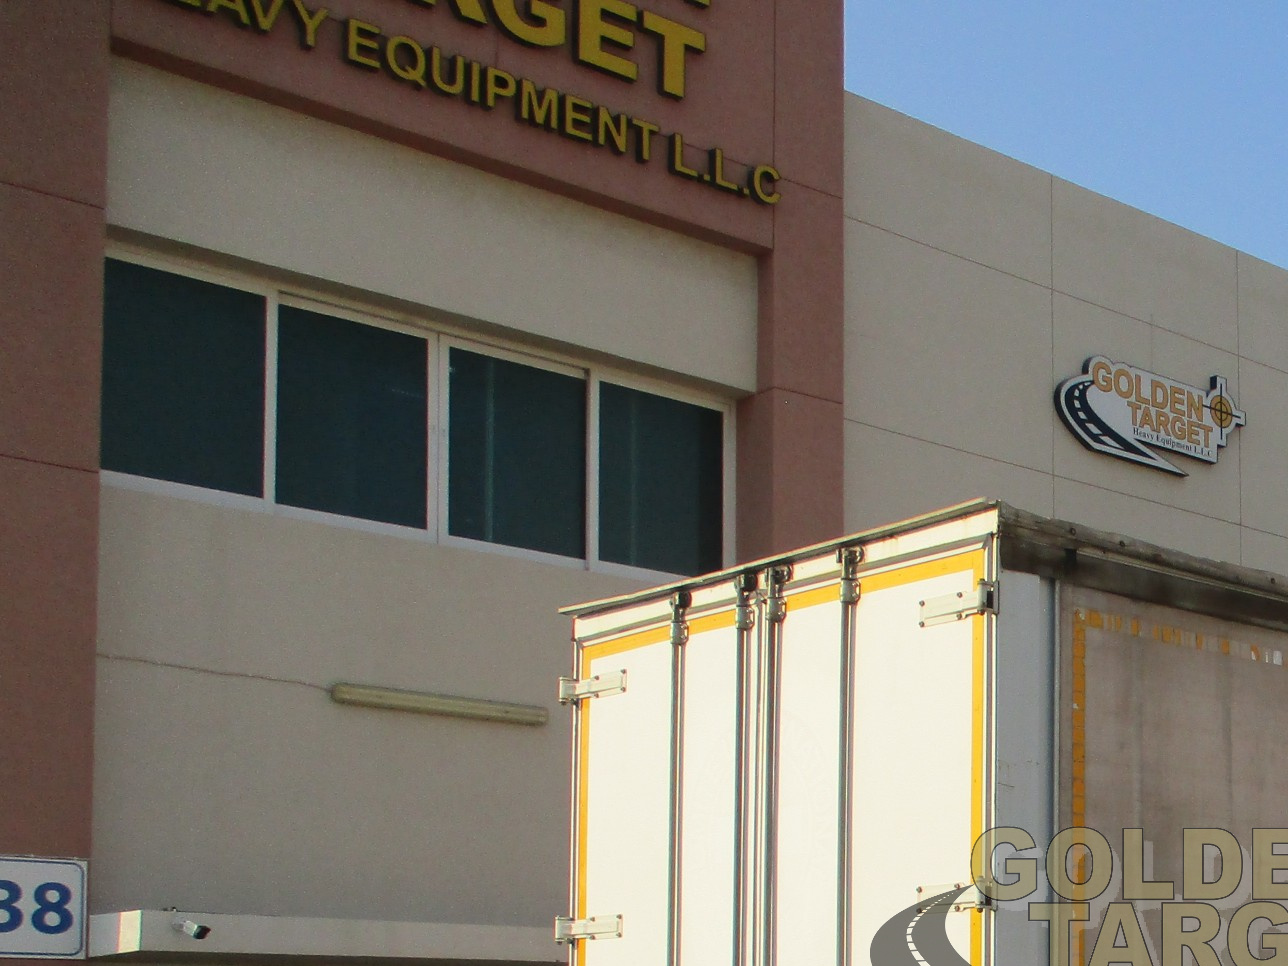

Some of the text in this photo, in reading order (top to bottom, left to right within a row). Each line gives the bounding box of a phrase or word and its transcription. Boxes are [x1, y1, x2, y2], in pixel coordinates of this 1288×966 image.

[347, 19, 660, 160] EQUIPMENT
[673, 132, 781, 204] L.L.C
[1092, 361, 1204, 422] GOLDEN
[1127, 400, 1214, 449] TARGET
[1133, 426, 1154, 442] Heavy
